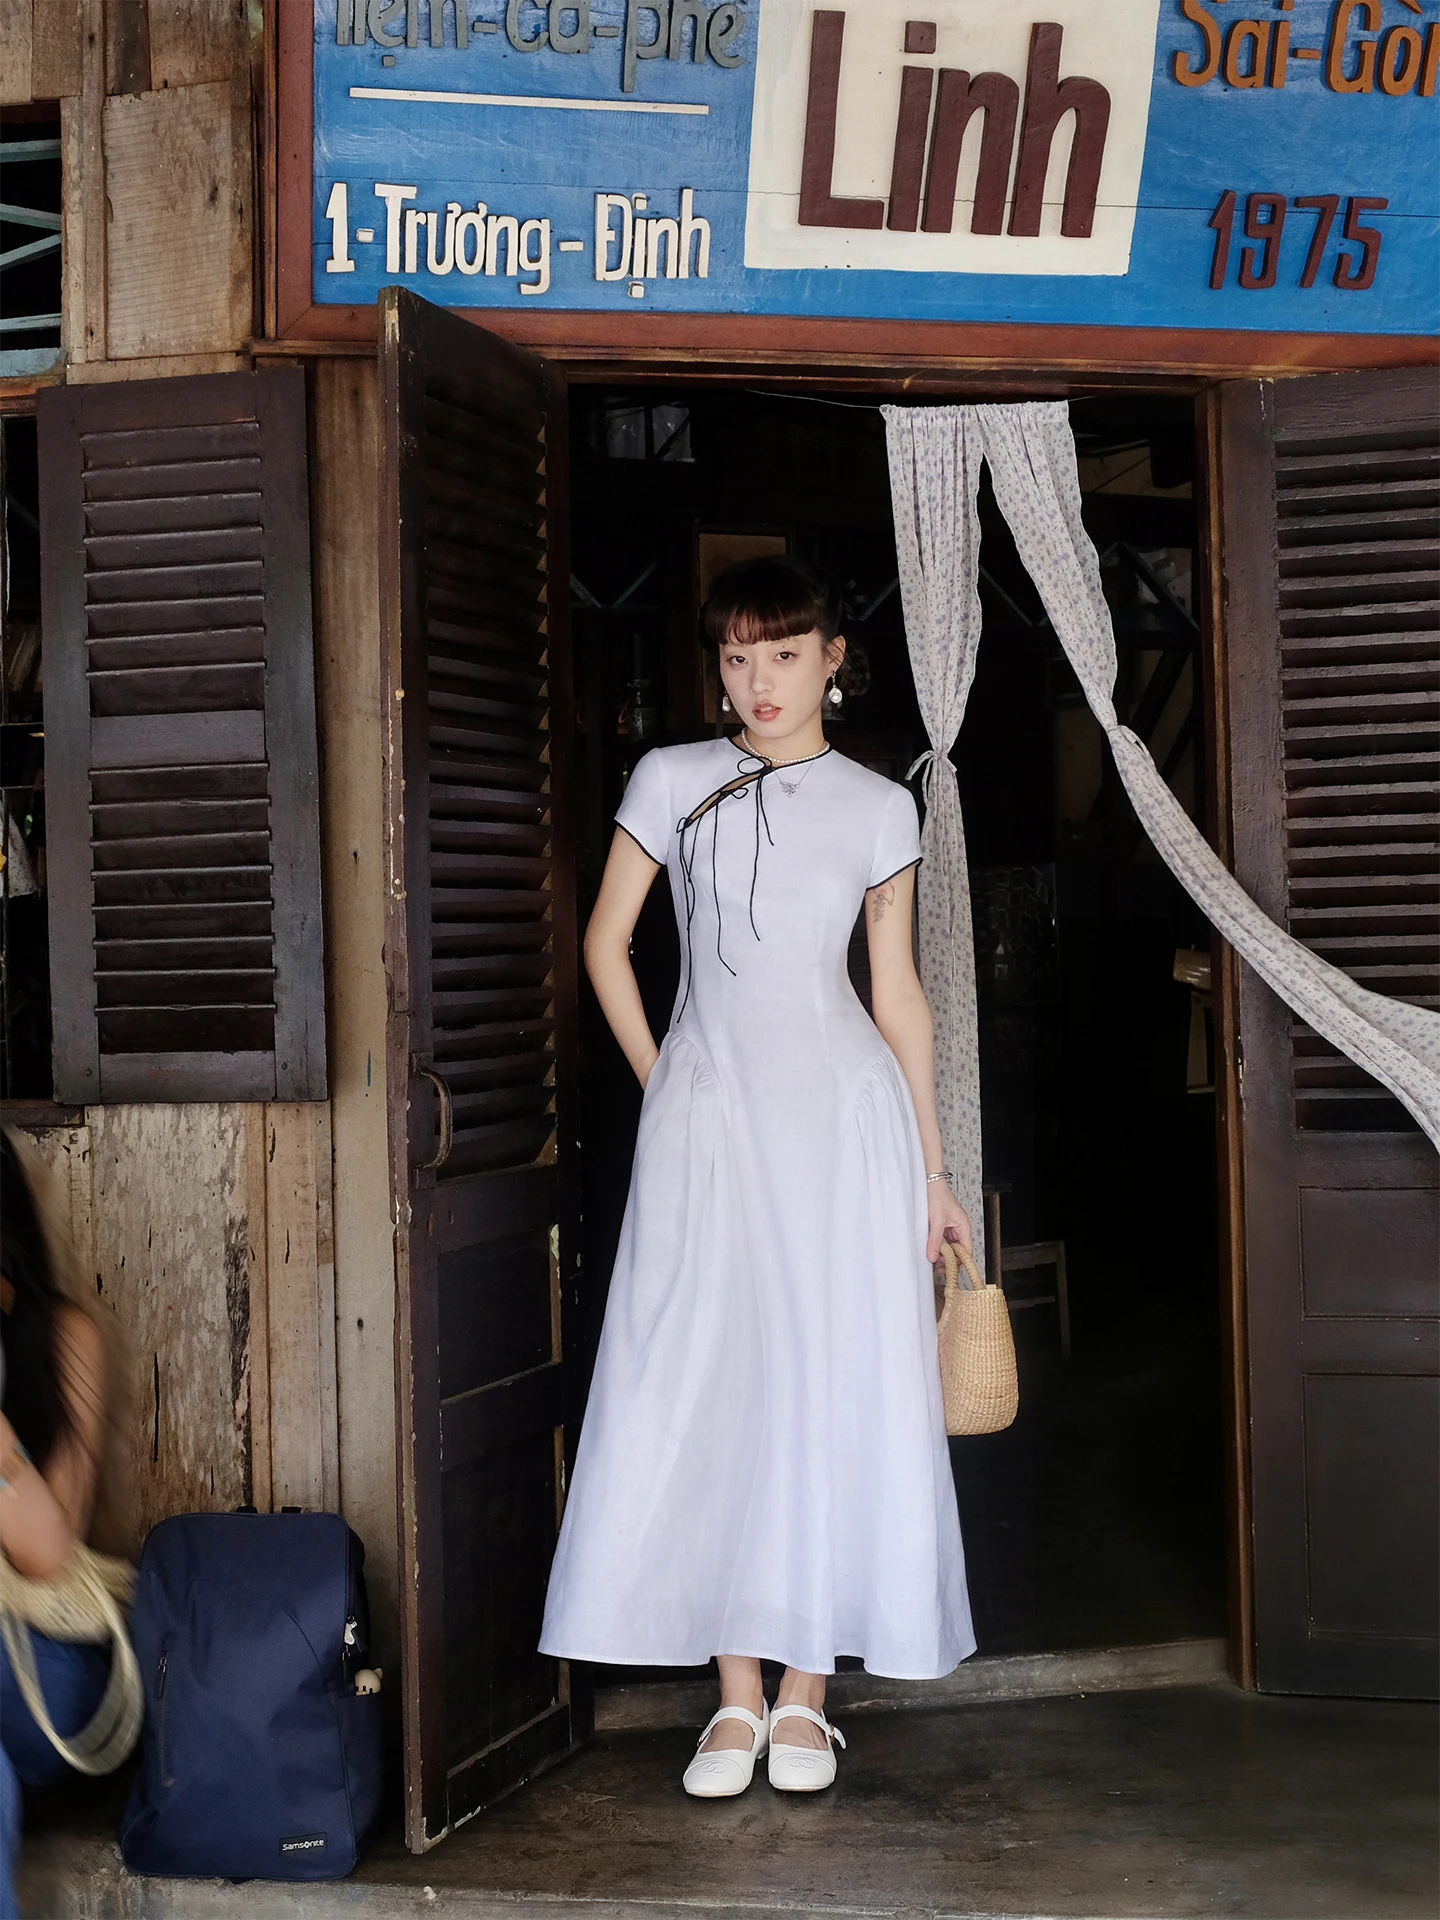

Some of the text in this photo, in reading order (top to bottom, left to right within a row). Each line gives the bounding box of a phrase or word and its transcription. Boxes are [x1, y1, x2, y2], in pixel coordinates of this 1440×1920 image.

[798, 10, 1111, 238] Linh
[1208, 190, 1389, 290] 1975
[282, 1839, 325, 1851] Samsonite
